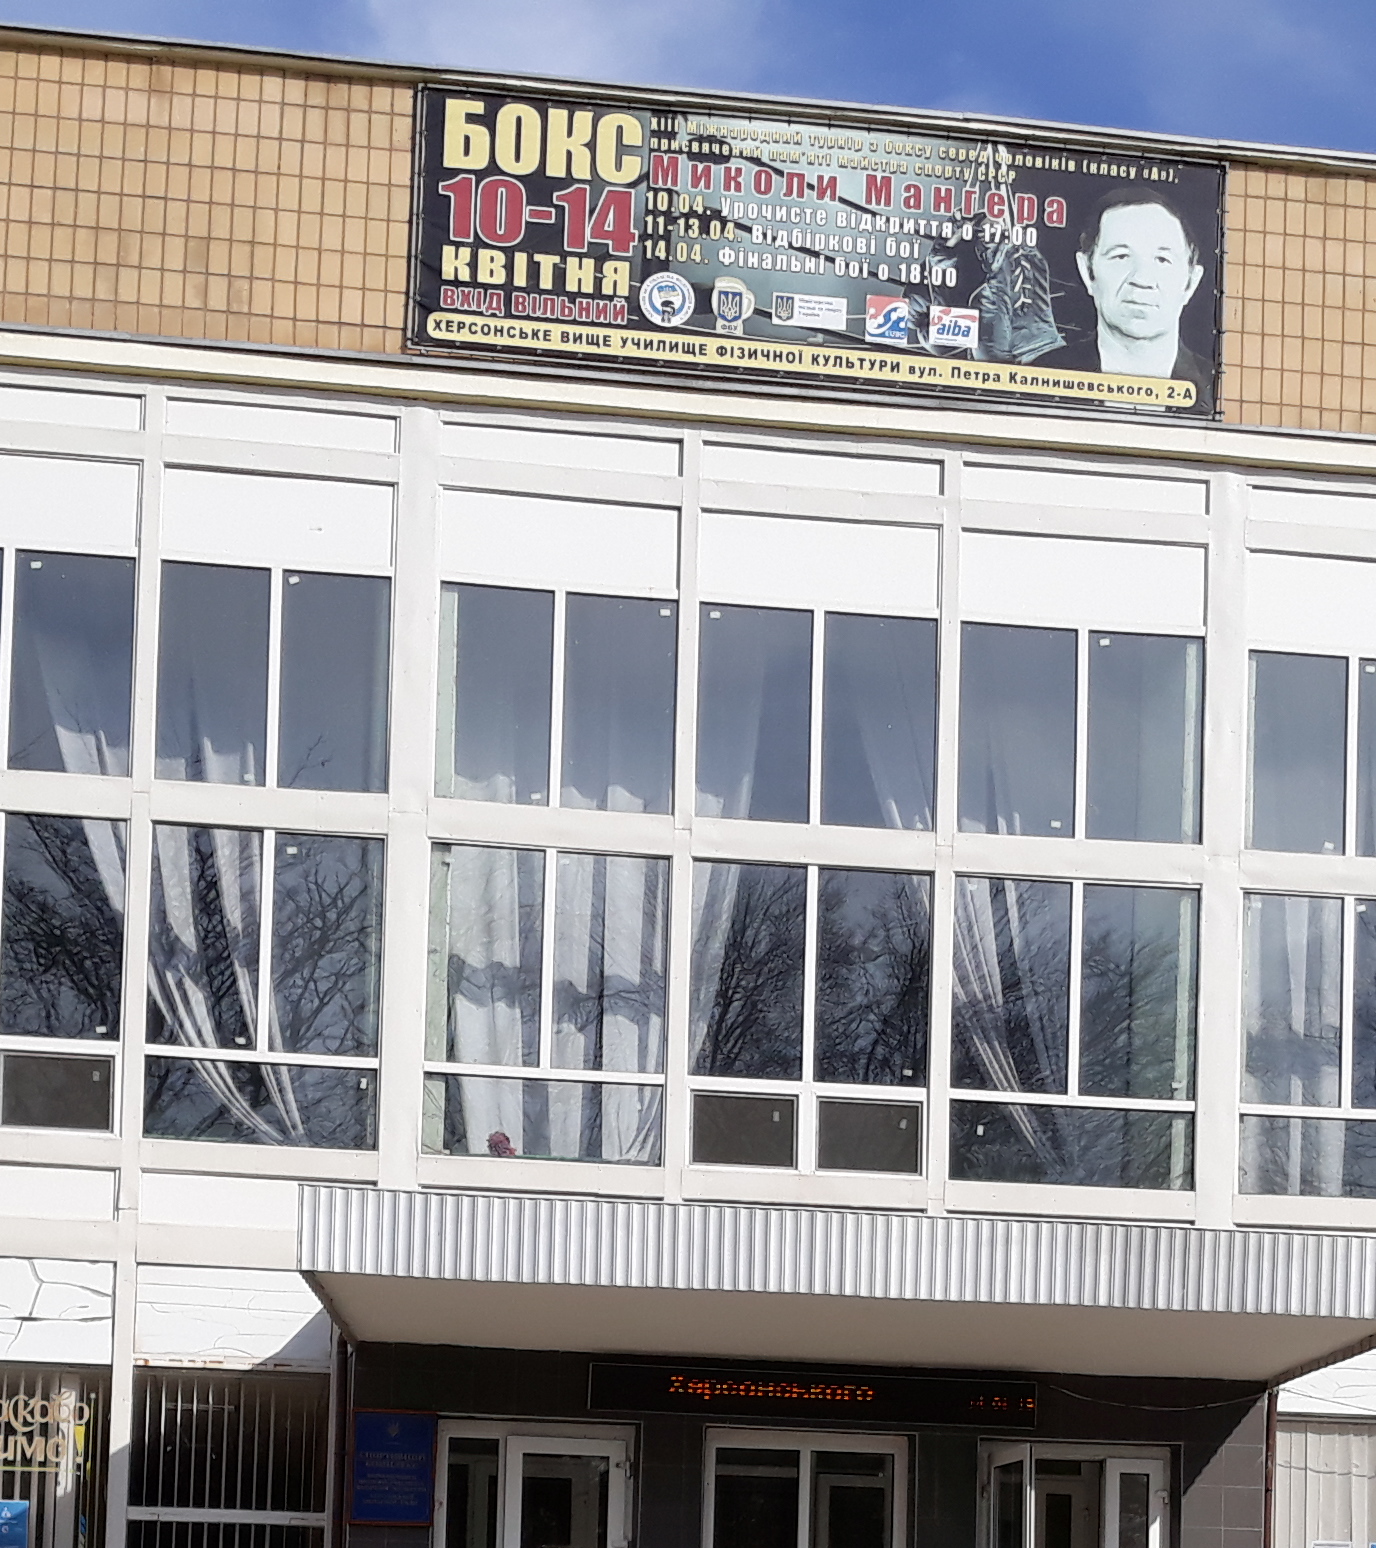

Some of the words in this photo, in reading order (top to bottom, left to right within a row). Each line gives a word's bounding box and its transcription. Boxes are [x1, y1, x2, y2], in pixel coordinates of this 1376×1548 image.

[443, 98, 643, 184] БОКС
[650, 137, 763, 159] присвячений
[837, 154, 908, 173] майстра
[915, 161, 972, 179] спорту
[977, 168, 1017, 184] СРСР
[809, 133, 864, 150] турнір
[884, 139, 933, 158] боксу
[939, 146, 990, 163] серед
[995, 152, 1076, 172] чоловіків
[439, 173, 639, 257] 10-14
[650, 152, 840, 204] Миколи
[863, 172, 1067, 228] Мангера
[644, 215, 743, 243] 11-13.04.
[751, 224, 876, 255] Відбіркові
[885, 236, 922, 259] бої
[645, 190, 712, 216] 10.04.
[720, 196, 828, 226] Урочисте
[836, 208, 953, 239] відкриття
[982, 223, 1038, 247] 17:00
[441, 244, 631, 297] КВІТНЯ
[643, 239, 710, 265] 14.04.
[718, 246, 830, 275] Фінальні
[834, 257, 870, 279] бої
[898, 263, 958, 288] 18:00
[440, 286, 505, 316] ВХІД
[511, 291, 628, 325] ВІЛЬНИЙ
[936, 319, 972, 338] aiba
[432, 319, 552, 342] ХЕРСОНСЬКЕ
[560, 330, 612, 348] ВИЩЕ
[620, 335, 708, 357] УЧИЛИЩЕ
[715, 345, 803, 365] ФІЗИЧНОЇ
[811, 353, 901, 374] КУЛЬТУРИ
[908, 365, 943, 379] вул.
[951, 366, 1001, 384] Петра
[1008, 371, 1160, 400] Калнишевського,
[1167, 386, 1194, 401] 2-А
